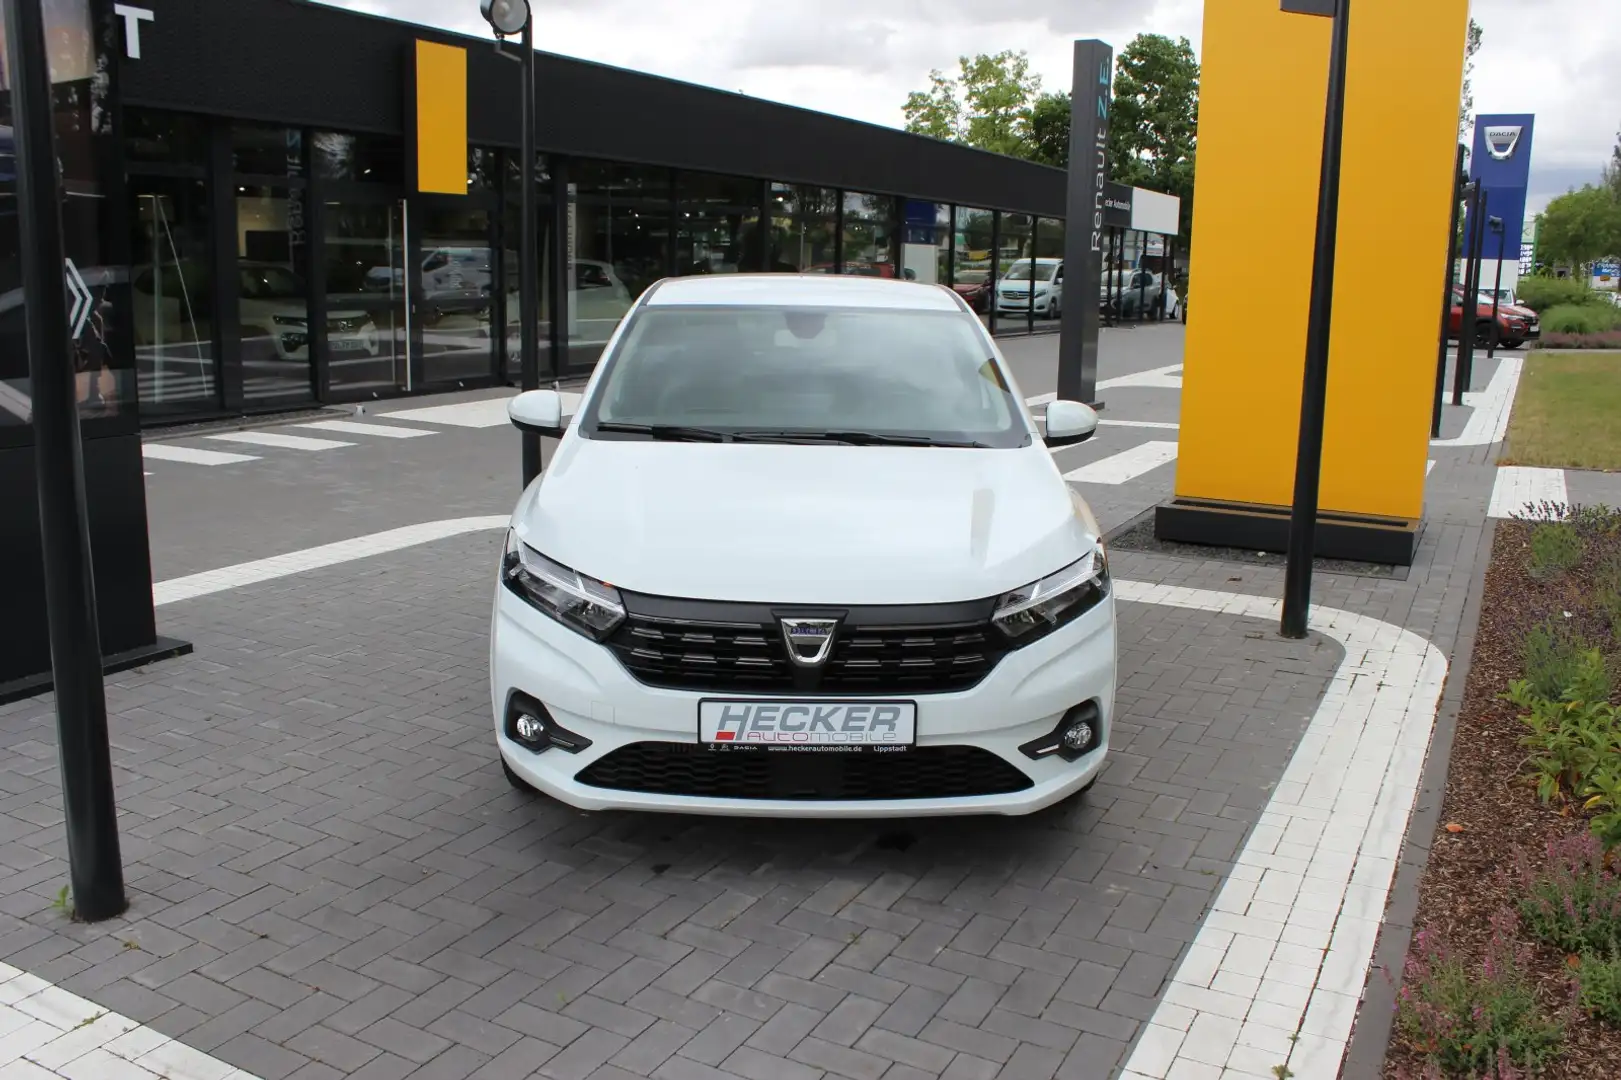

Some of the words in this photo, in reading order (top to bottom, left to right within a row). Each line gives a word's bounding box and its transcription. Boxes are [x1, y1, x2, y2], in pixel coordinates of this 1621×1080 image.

[1091, 127, 1107, 252] Renault
[717, 705, 901, 741] HECKER
[873, 744, 907, 753] Lippstadt
